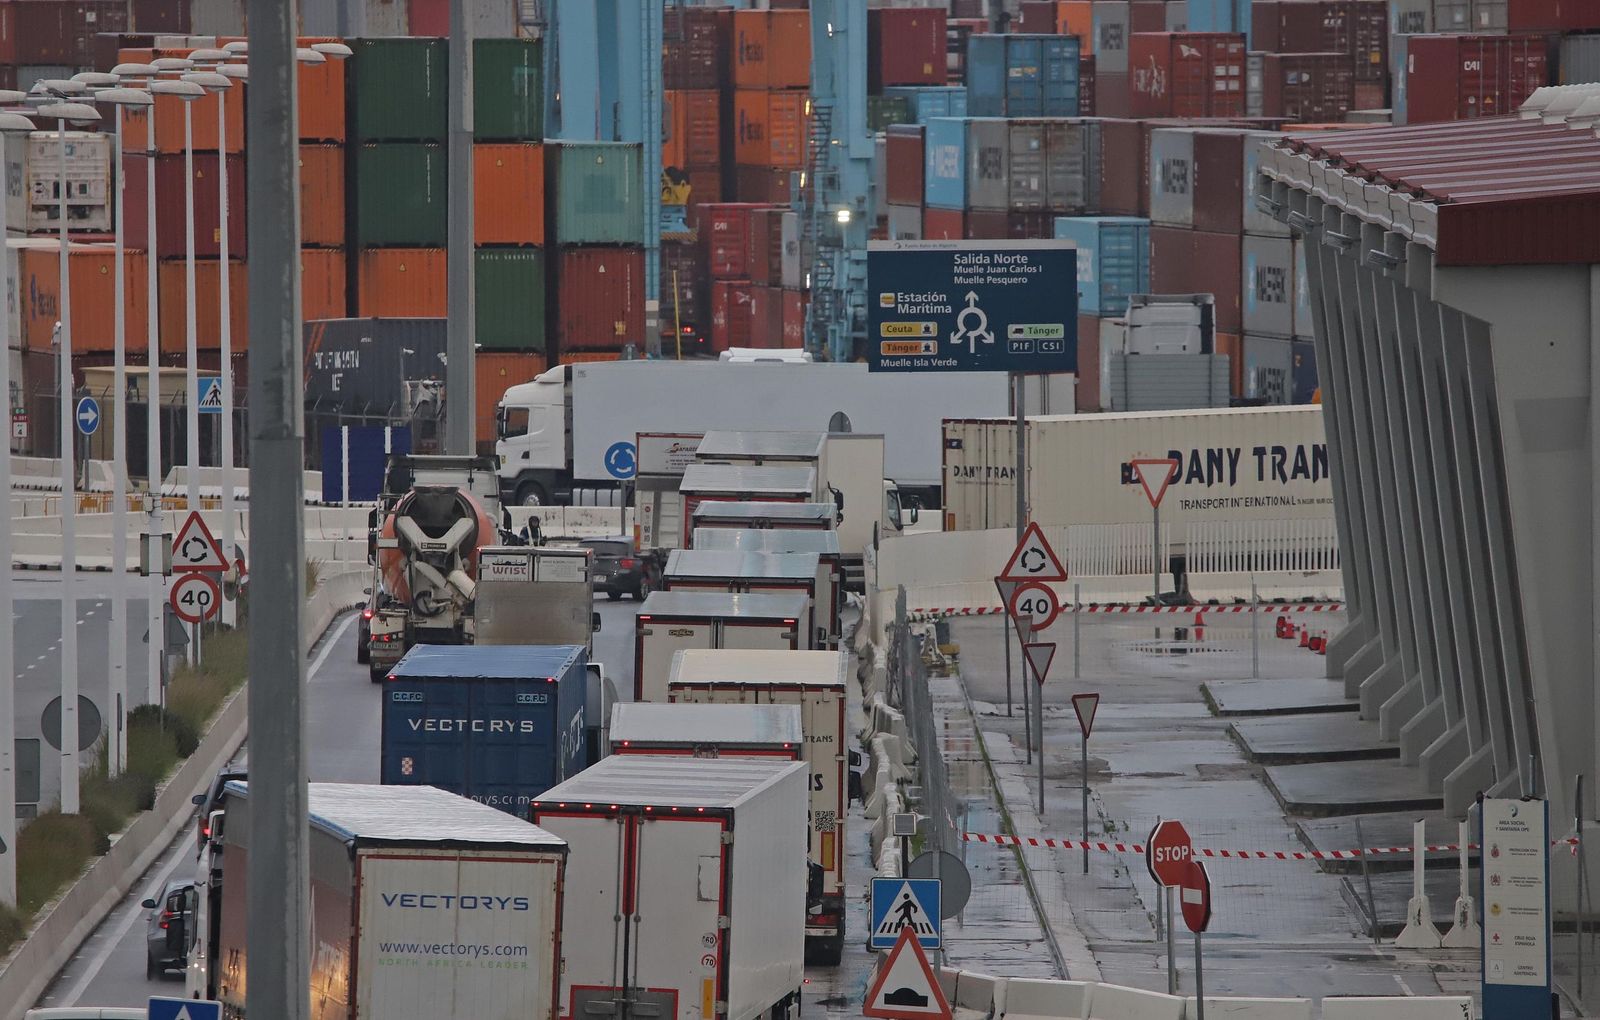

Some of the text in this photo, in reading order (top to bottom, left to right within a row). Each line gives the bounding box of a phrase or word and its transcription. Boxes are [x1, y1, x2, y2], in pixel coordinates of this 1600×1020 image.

[1464, 60, 1480, 70] CAI
[714, 222, 727, 230] CAI
[954, 254, 1028, 264] Salida Norte
[954, 265, 984, 274] Muelle
[986, 265, 1006, 273] Juan
[1010, 265, 1037, 273] Carlos
[954, 276, 1028, 286] Muelle Pesquero
[898, 291, 946, 302] Estación
[898, 303, 952, 314] Marítima
[886, 325, 913, 333] Ceuta
[1028, 326, 1060, 336] Tánger
[887, 343, 918, 353] Tánger
[1012, 342, 1030, 351] PIF
[1042, 342, 1060, 350] CSI
[881, 358, 958, 367] Muelle Isla Verde
[1168, 444, 1329, 488] DANY TRAN
[954, 465, 1016, 480] DANY TRAN
[1180, 498, 1229, 510] TRANSPORT
[1230, 496, 1296, 507] INTERNATIONAL
[492, 566, 526, 575] wrist
[181, 590, 210, 606] 40
[1020, 599, 1049, 615] 40
[408, 719, 534, 733] VECTORYS
[1156, 846, 1189, 862] STOP
[381, 893, 529, 911] VECTORYS
[379, 942, 528, 959] www.vectorys.com
[378, 958, 528, 969] NORTH AFRICA LEADER
